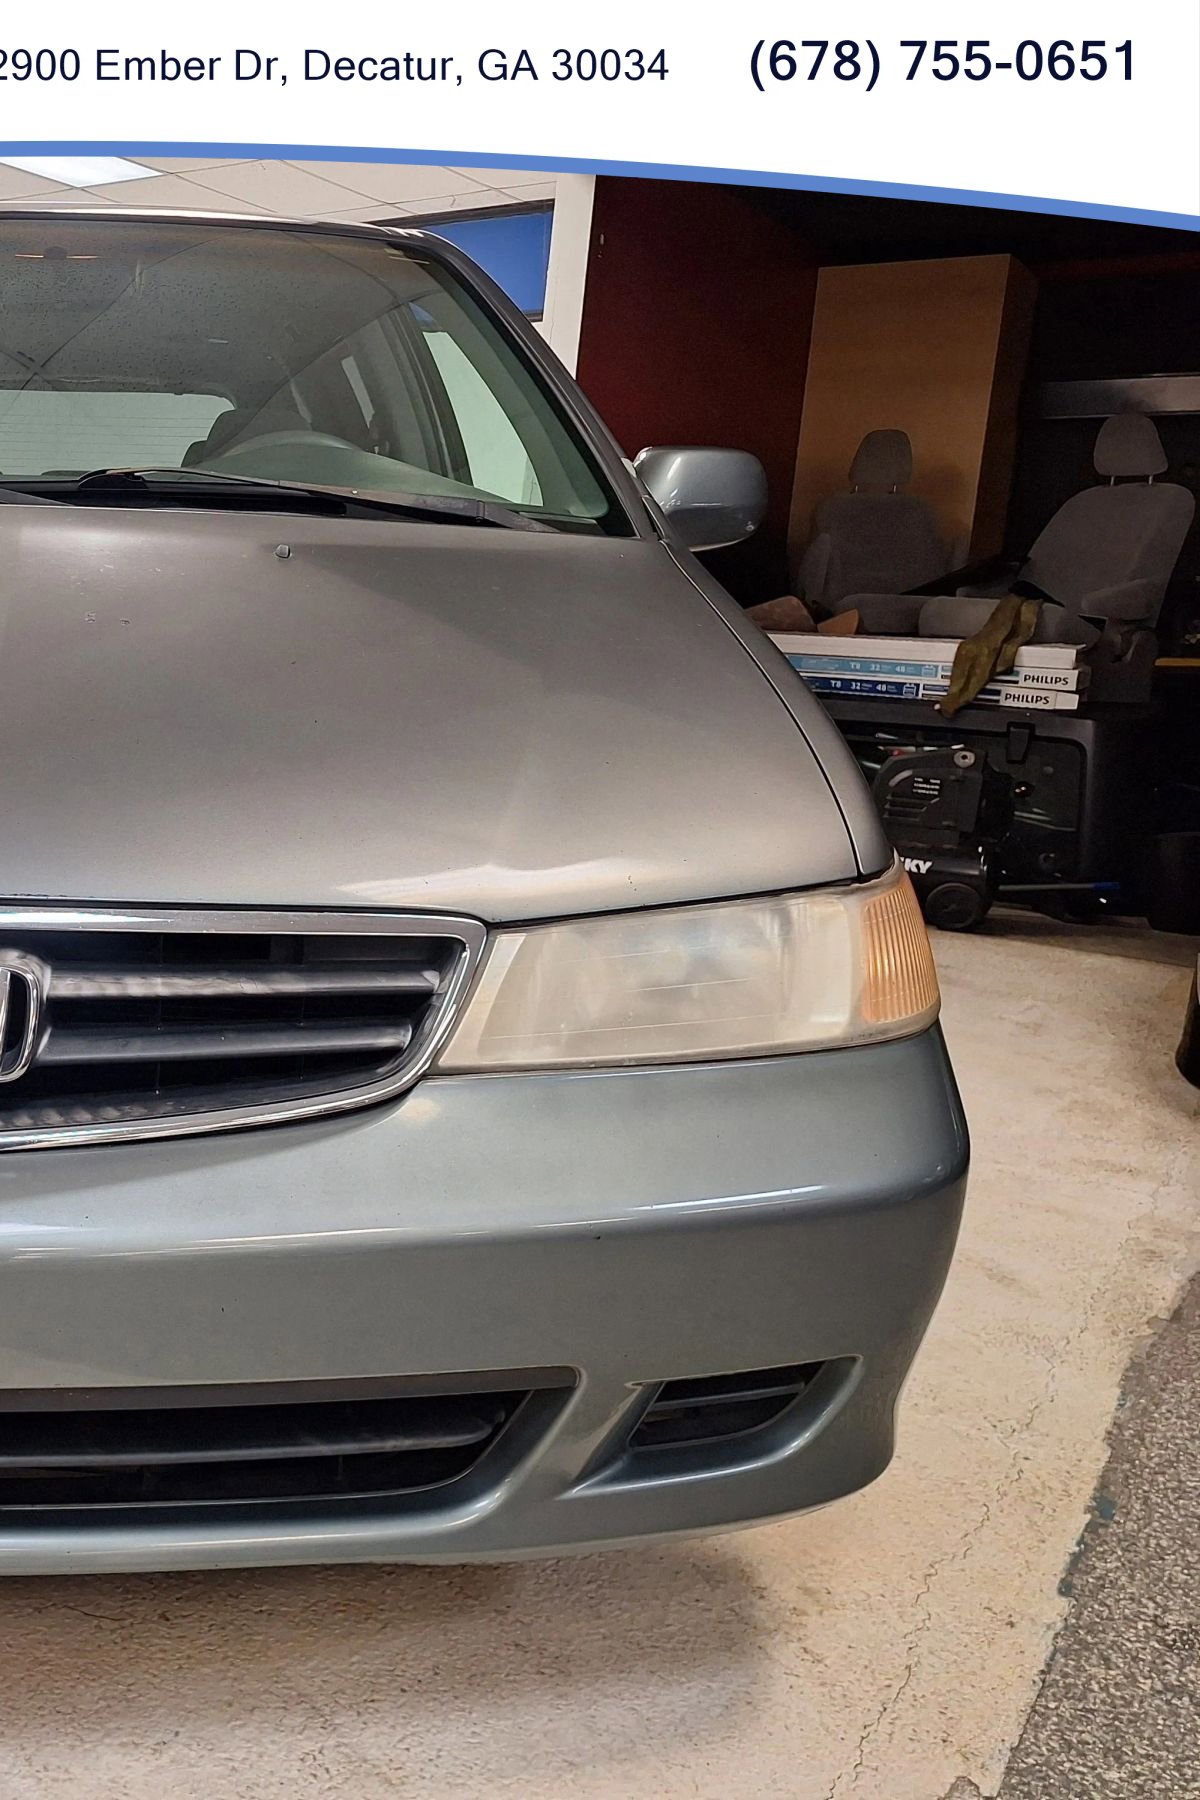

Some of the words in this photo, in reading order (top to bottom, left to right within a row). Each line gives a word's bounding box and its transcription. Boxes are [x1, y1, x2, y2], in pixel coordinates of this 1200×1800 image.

[850, 682, 861, 690] 32
[1023, 674, 1069, 686] PHILIPS
[1004, 692, 1050, 705] PHILIPS
[900, 856, 932, 875] KY
